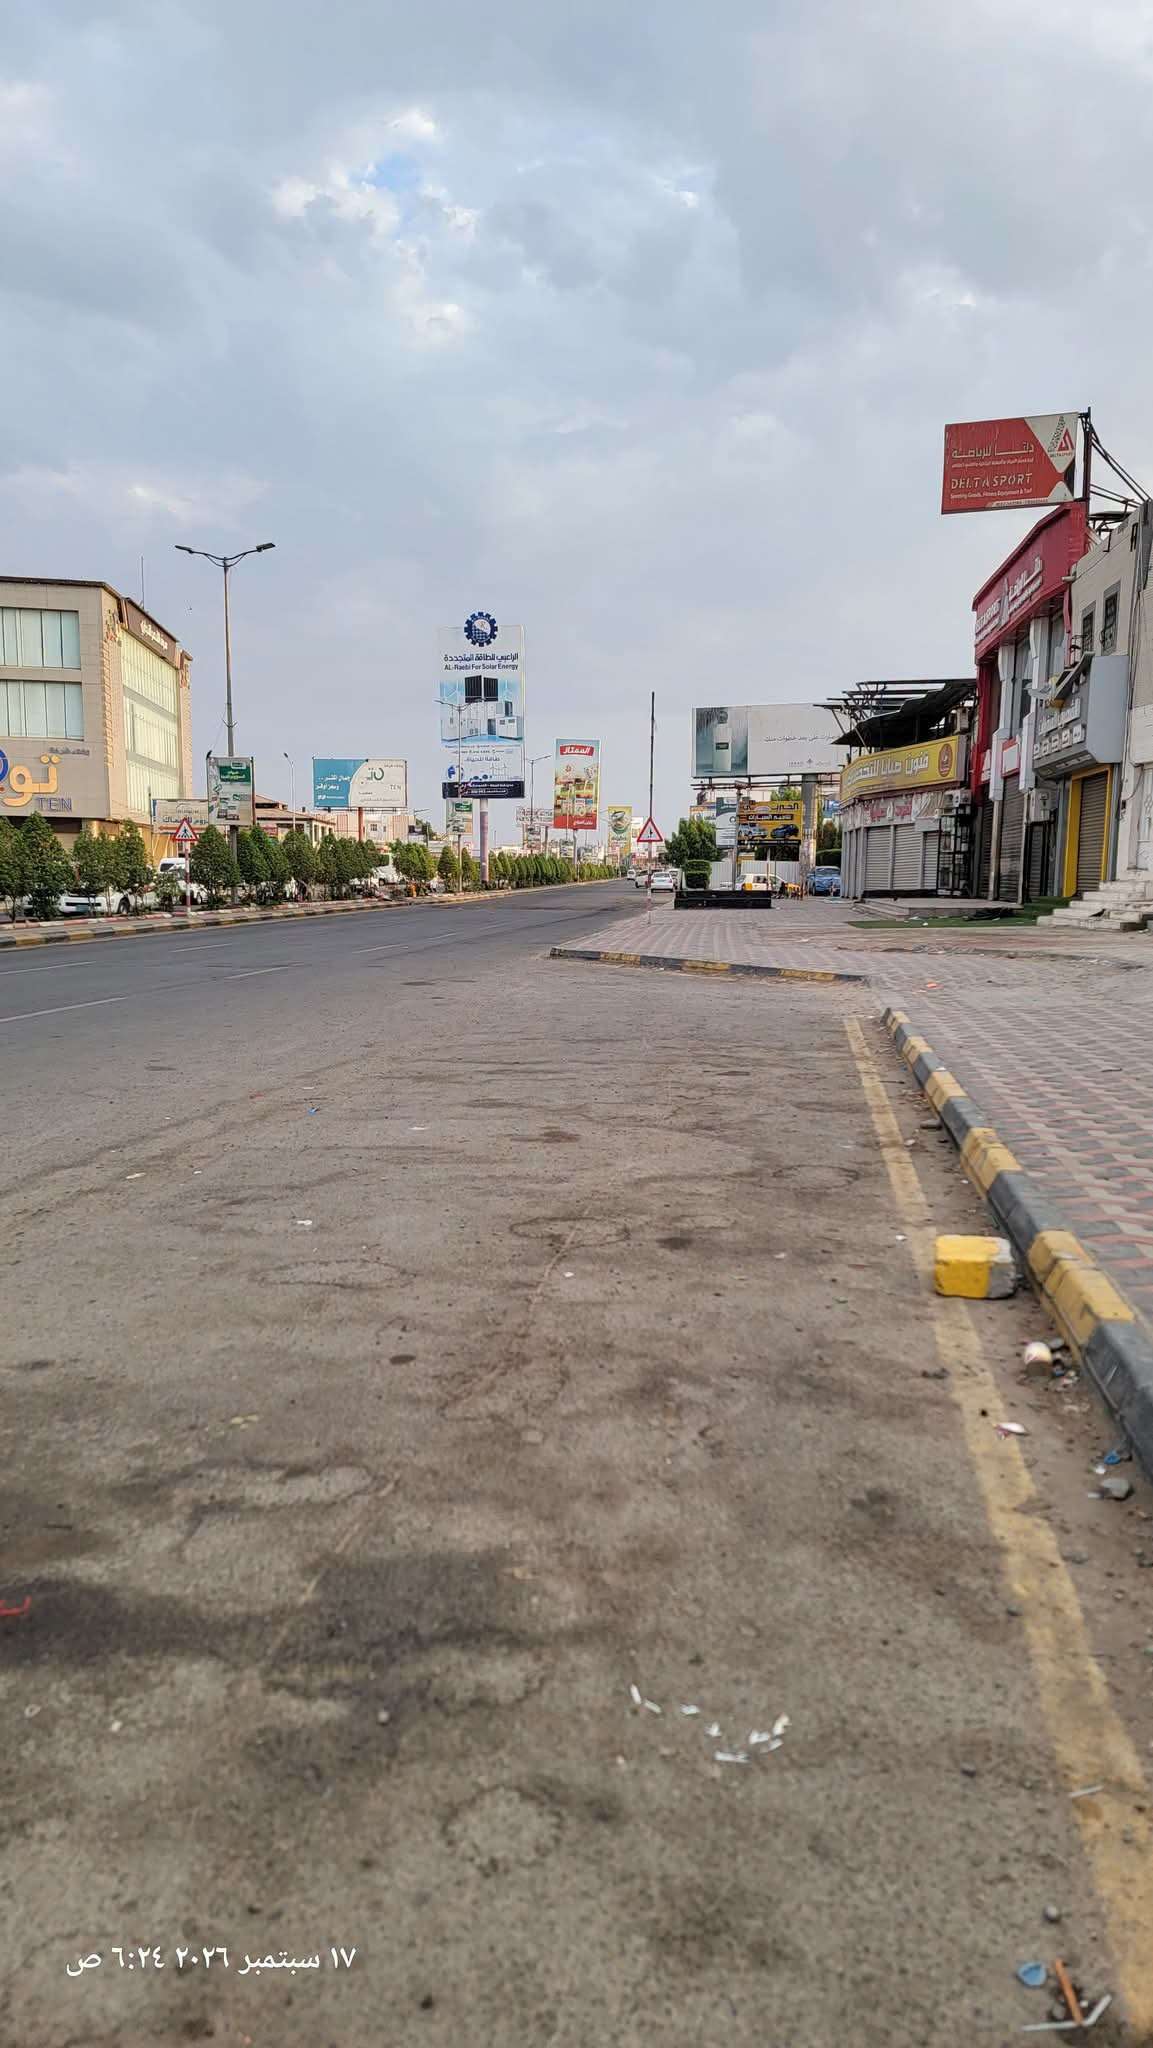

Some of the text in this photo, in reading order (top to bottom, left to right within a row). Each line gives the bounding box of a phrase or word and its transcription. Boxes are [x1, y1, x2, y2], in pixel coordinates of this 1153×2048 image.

[951, 473, 1032, 490] DELTA SPORT
[497, 663, 519, 671] Energy
[37, 797, 72, 812] TEN
